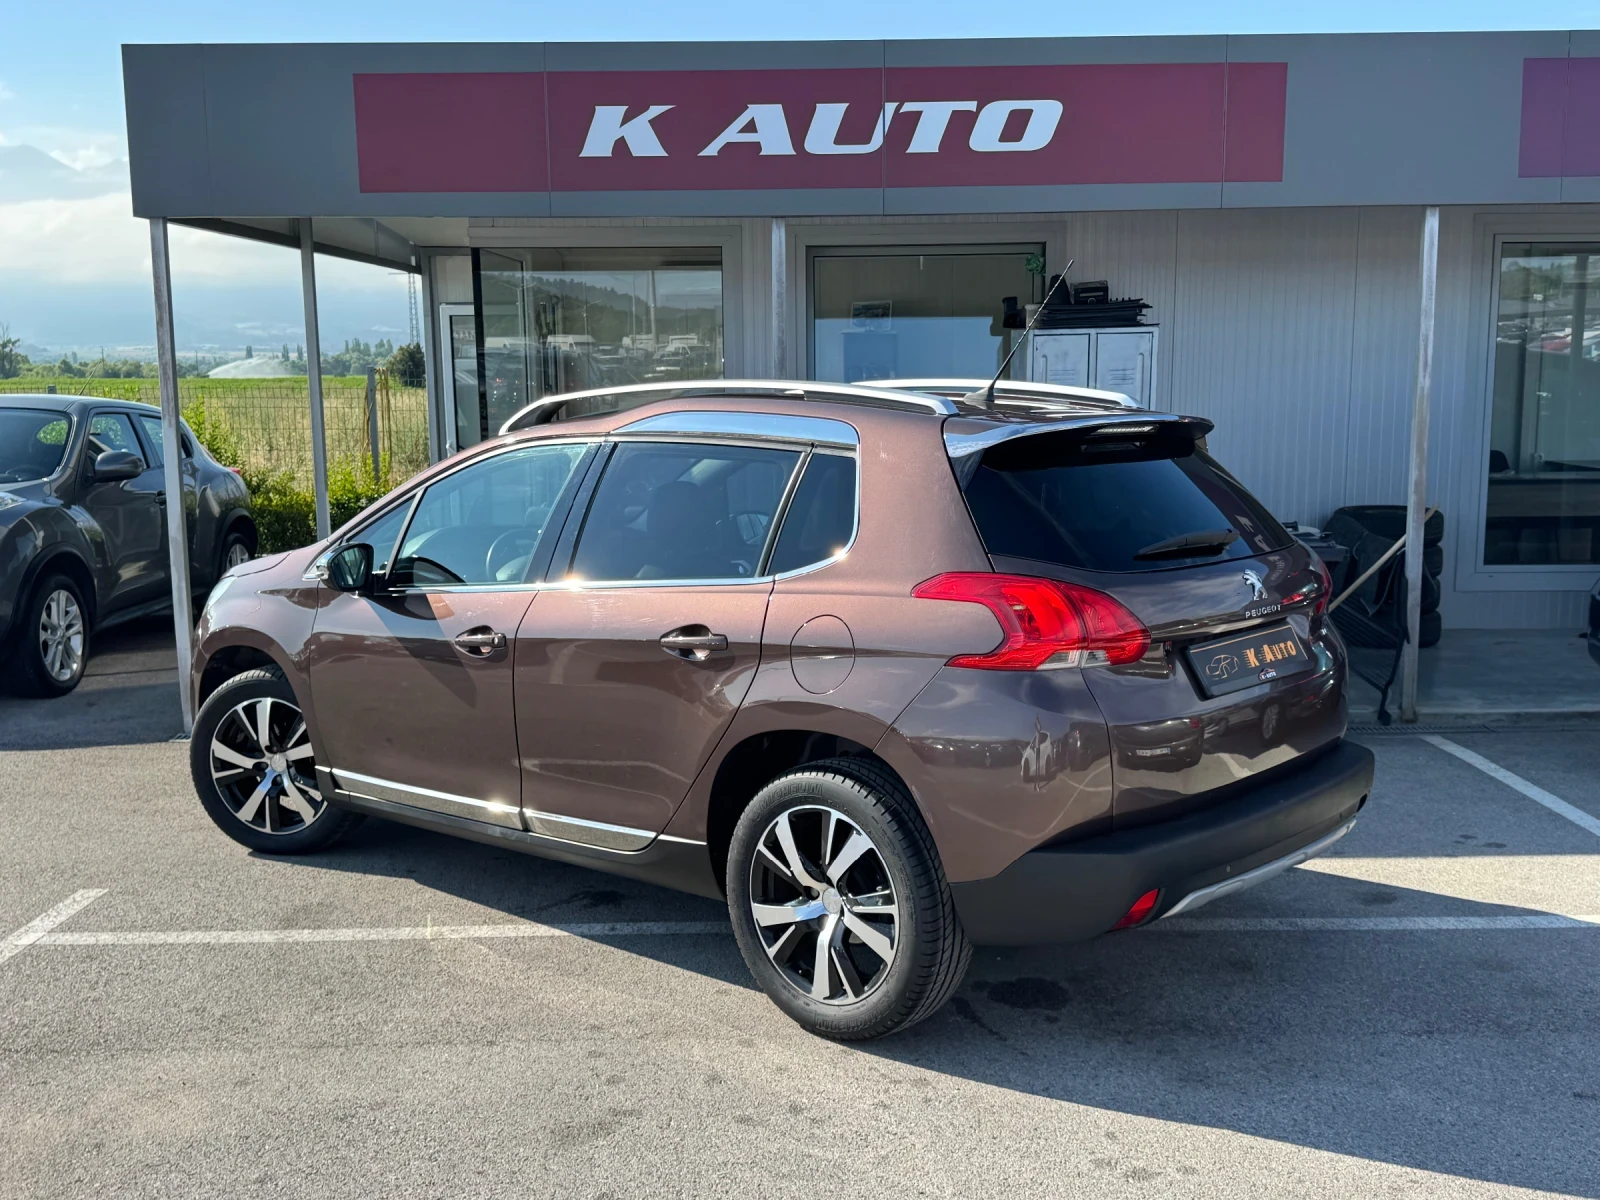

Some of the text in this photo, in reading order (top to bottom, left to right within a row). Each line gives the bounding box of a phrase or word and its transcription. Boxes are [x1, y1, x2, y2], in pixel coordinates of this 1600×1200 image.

[578, 99, 1064, 157] K AUTO
[1245, 604, 1281, 618] PEUGEOT
[1242, 641, 1296, 668] K AUTO
[760, 782, 823, 810] MICHELIN
